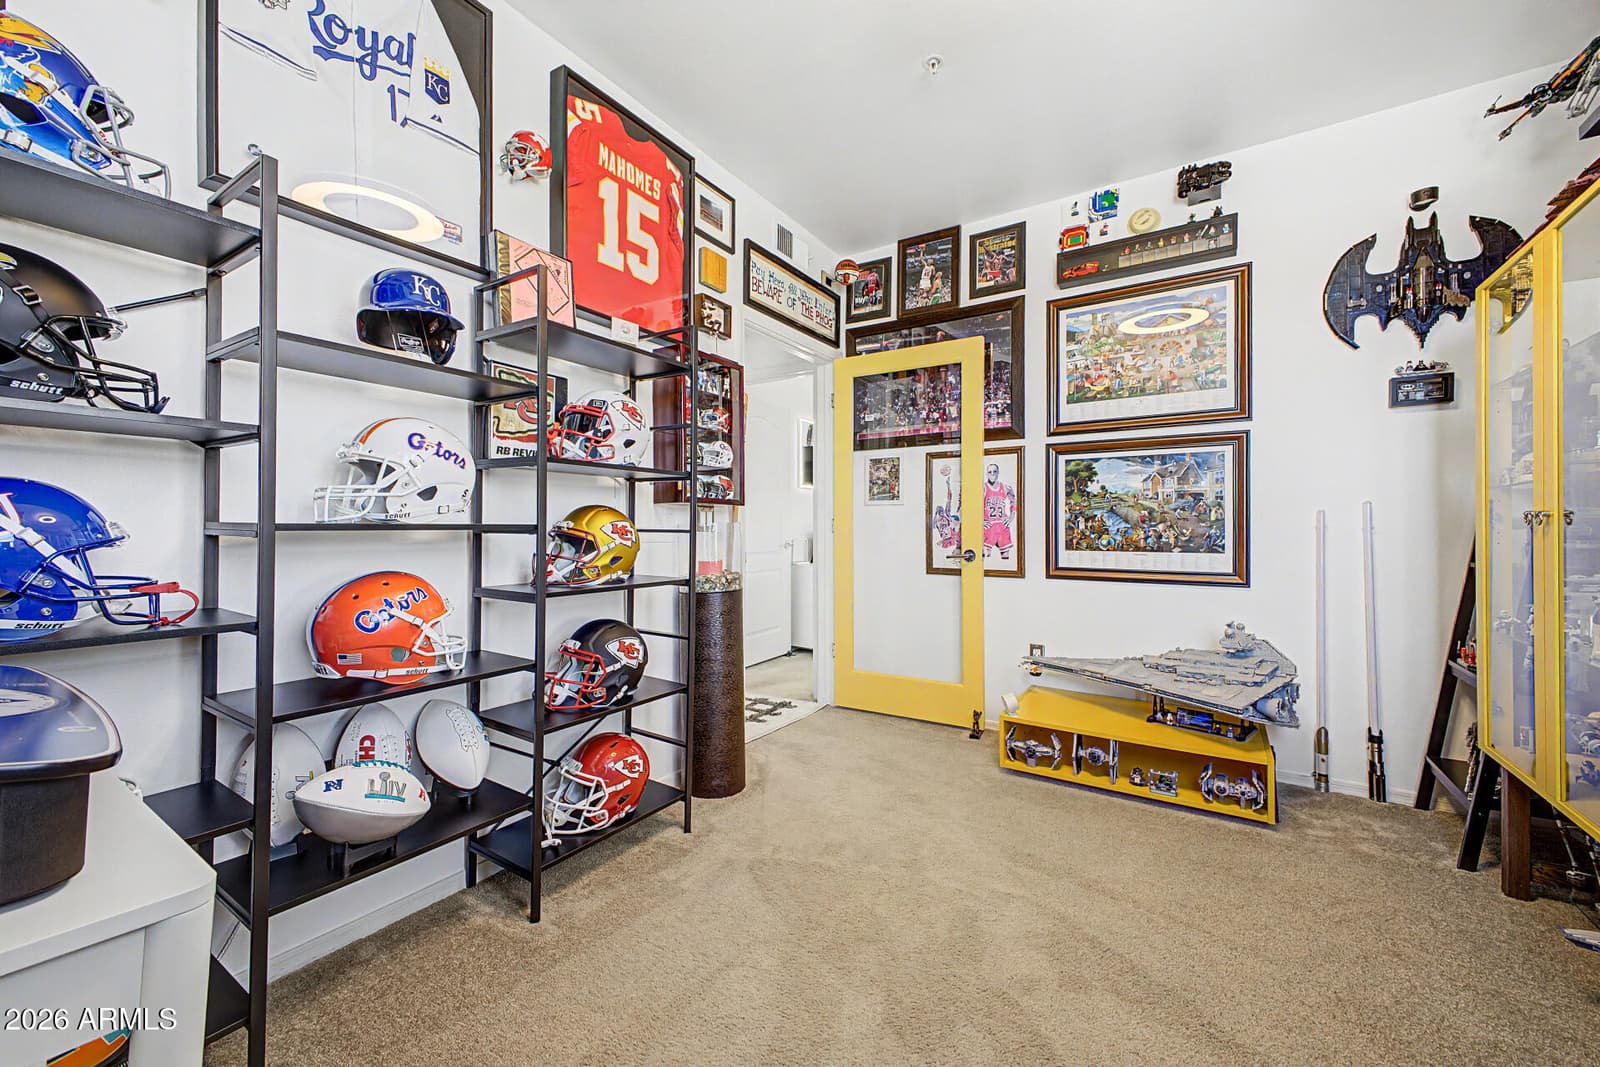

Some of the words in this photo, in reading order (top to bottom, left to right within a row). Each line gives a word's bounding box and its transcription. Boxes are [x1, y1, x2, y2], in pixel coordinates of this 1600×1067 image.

[307, 0, 416, 81] Royal
[426, 73, 448, 101] KC
[598, 142, 661, 201] MAHOMES
[597, 176, 660, 286] 15
[411, 274, 441, 307] KC
[751, 276, 783, 305] BEWARE
[787, 297, 797, 311] OF
[10, 380, 63, 395] schutt
[496, 446, 511, 456] RB
[989, 506, 1002, 518] 23
